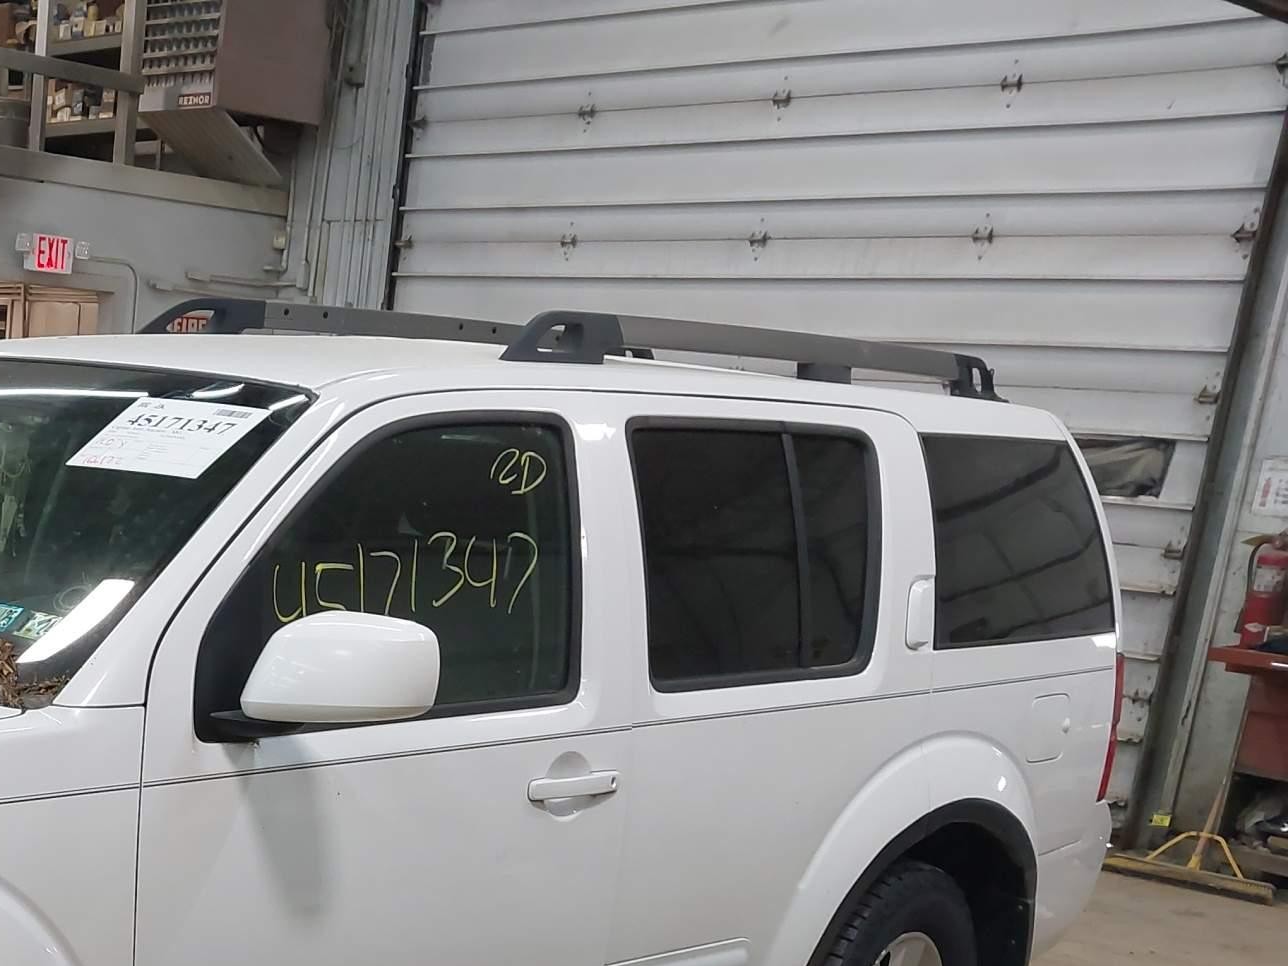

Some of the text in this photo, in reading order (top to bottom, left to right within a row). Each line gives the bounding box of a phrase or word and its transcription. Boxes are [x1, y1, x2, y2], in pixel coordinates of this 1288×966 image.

[37, 236, 68, 270] EXIT
[128, 414, 238, 435] 45171347
[273, 532, 538, 623] 45171347
